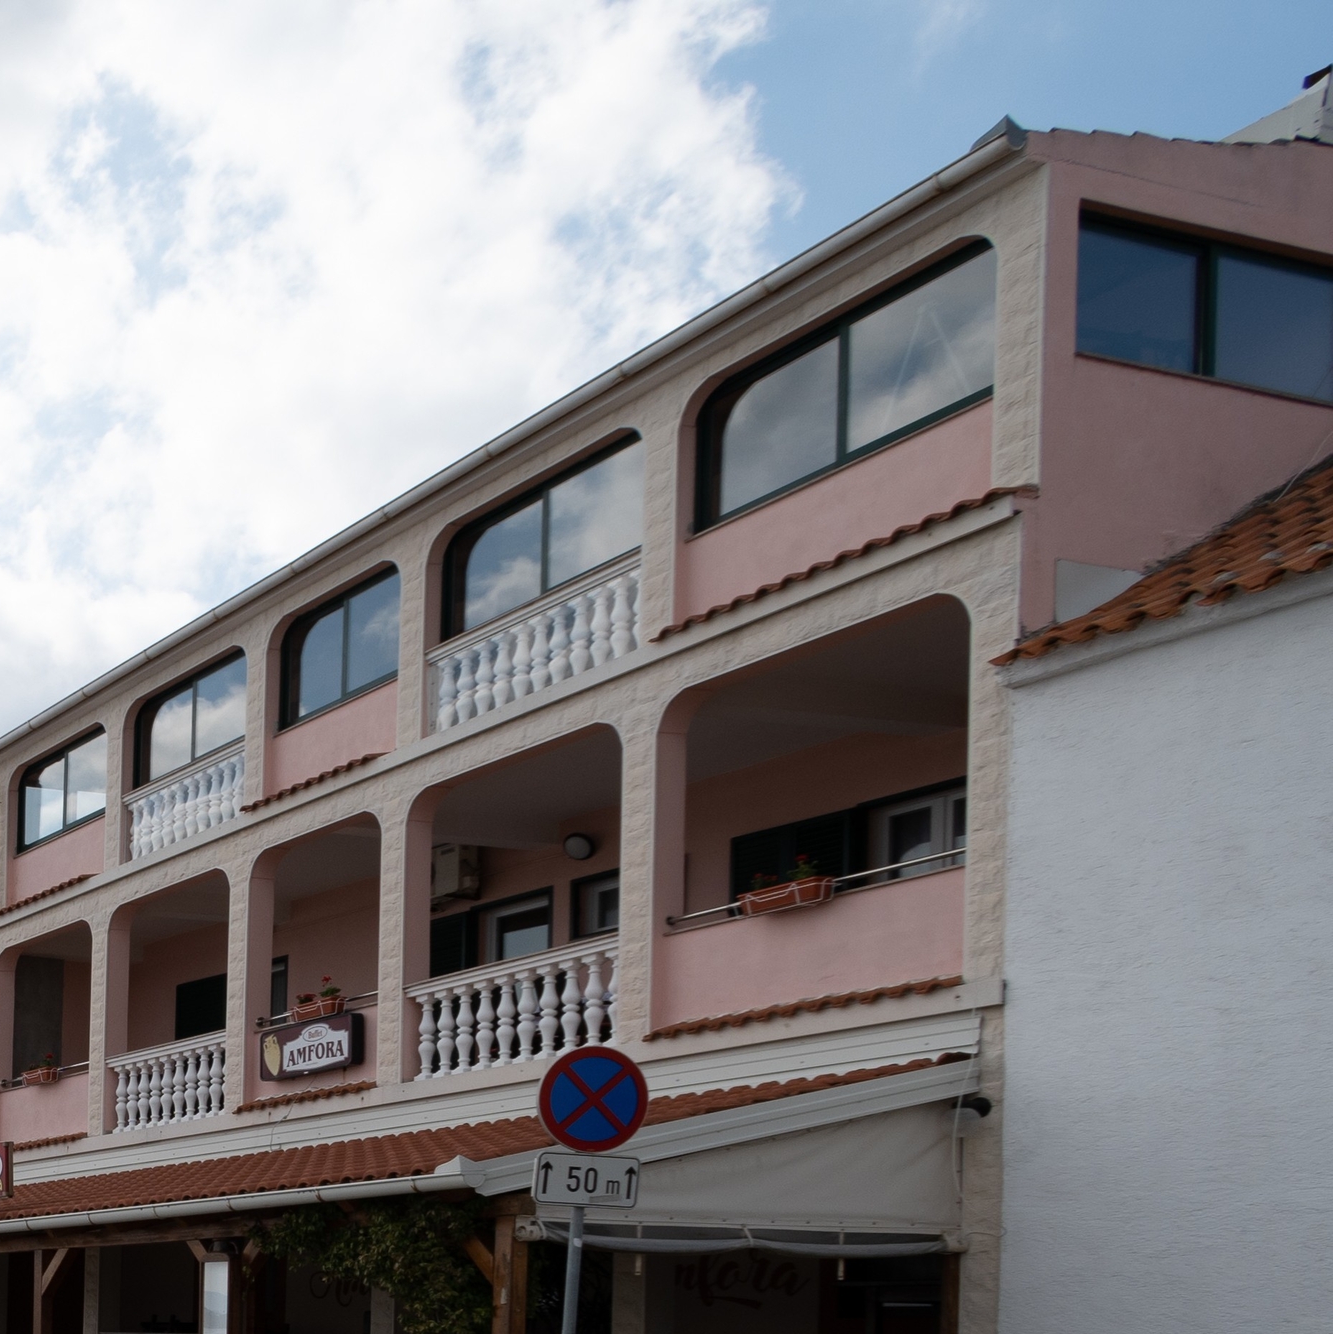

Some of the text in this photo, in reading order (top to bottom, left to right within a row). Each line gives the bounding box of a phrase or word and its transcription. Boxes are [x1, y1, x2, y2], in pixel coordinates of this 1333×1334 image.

[308, 1029, 323, 1040] Buffet
[286, 1040, 345, 1068] AMFORA
[566, 1166, 620, 1195] 50 m
